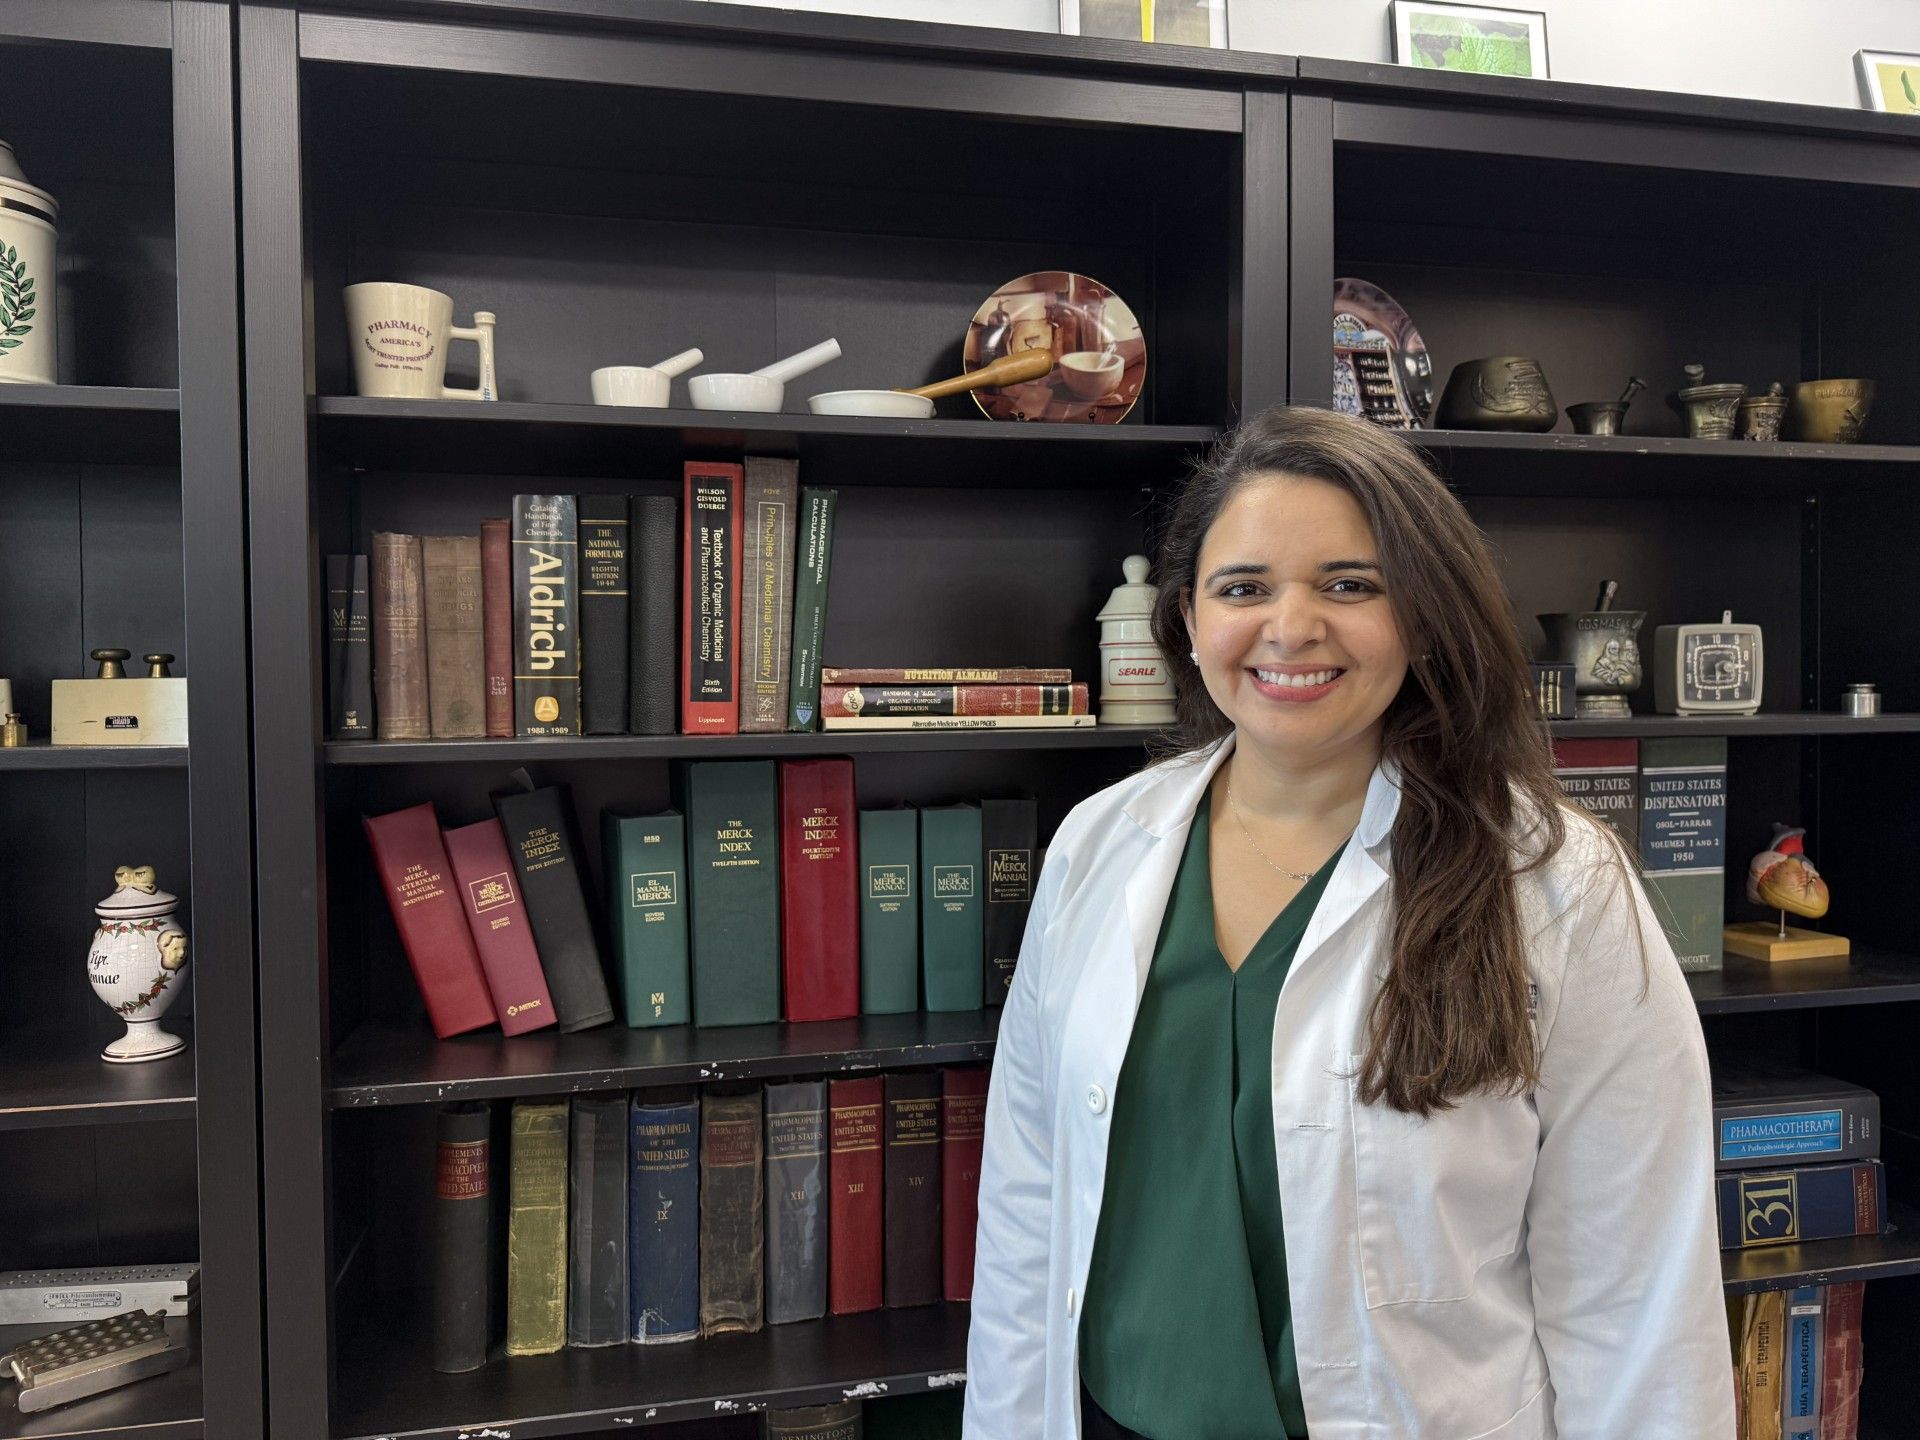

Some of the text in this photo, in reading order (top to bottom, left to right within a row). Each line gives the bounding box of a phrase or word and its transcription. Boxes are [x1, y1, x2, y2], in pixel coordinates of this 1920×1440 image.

[368, 320, 432, 339] PHARMACY
[380, 337, 421, 347] AMERICA'S
[377, 350, 405, 361] TRUSTED
[530, 504, 558, 513] Catalog
[526, 529, 563, 537] Chemicals
[598, 529, 612, 537] THE
[808, 498, 819, 568] CALCULATIONS
[588, 540, 621, 548] NATIONAL
[816, 499, 828, 585] PHARMACEUTICAL
[585, 550, 624, 558] FORMULARY
[700, 527, 711, 662] and Pharmaceutical Chemistry
[712, 527, 724, 662] Textbook of Organic Medicinal
[761, 507, 776, 678] Principles of Medicinal Chemistry
[529, 547, 566, 671] Aldrich
[1712, 634, 1721, 644] 10
[904, 671, 953, 681] NUTRITION
[956, 670, 998, 680] ALMANAC
[1118, 668, 1156, 676] SEARLE
[848, 692, 858, 710] CRC
[1559, 778, 1631, 791] NITED STATES
[1650, 779, 1721, 792] UNITED STATES
[1644, 794, 1726, 810] DISPENSATORY
[802, 816, 839, 827] MERCK
[528, 827, 548, 838] THE
[717, 829, 753, 840] MERCK
[804, 830, 837, 840] INDEX
[520, 832, 560, 850] MERCK
[1651, 840, 1685, 849] VOLUMES
[1696, 839, 1712, 847] AND
[525, 842, 561, 859] INDEX
[720, 842, 752, 853] INDEX
[543, 856, 566, 867] EDITION
[999, 853, 1020, 861] THE
[1672, 852, 1694, 862] 1950
[406, 864, 422, 873] THE
[712, 859, 738, 867] TWELFTH
[993, 860, 1027, 872] MERCK
[404, 870, 429, 882] MERCK
[873, 877, 906, 885] MERCK
[937, 877, 970, 885] MERCK
[992, 872, 1027, 882] MANUAL
[397, 873, 441, 892] VETERINARY
[406, 884, 436, 897] MANUAL
[636, 885, 671, 893] MANUAL
[637, 891, 672, 901] MERCK
[519, 1000, 542, 1012] MERCK
[896, 1118, 937, 1128] UNITED STATES
[1731, 1119, 1834, 1138] PHARMACOTHERAPY
[834, 1124, 876, 1136] UNITED STATES
[771, 1132, 823, 1144] UNITED STATES
[1797, 1139, 1824, 1150] Approach
[637, 1149, 690, 1161] UNITED STATES
[908, 1176, 925, 1186] XIV
[848, 1183, 864, 1194] XIII
[1745, 1180, 1794, 1236] 31
[657, 1210, 668, 1220] IX
